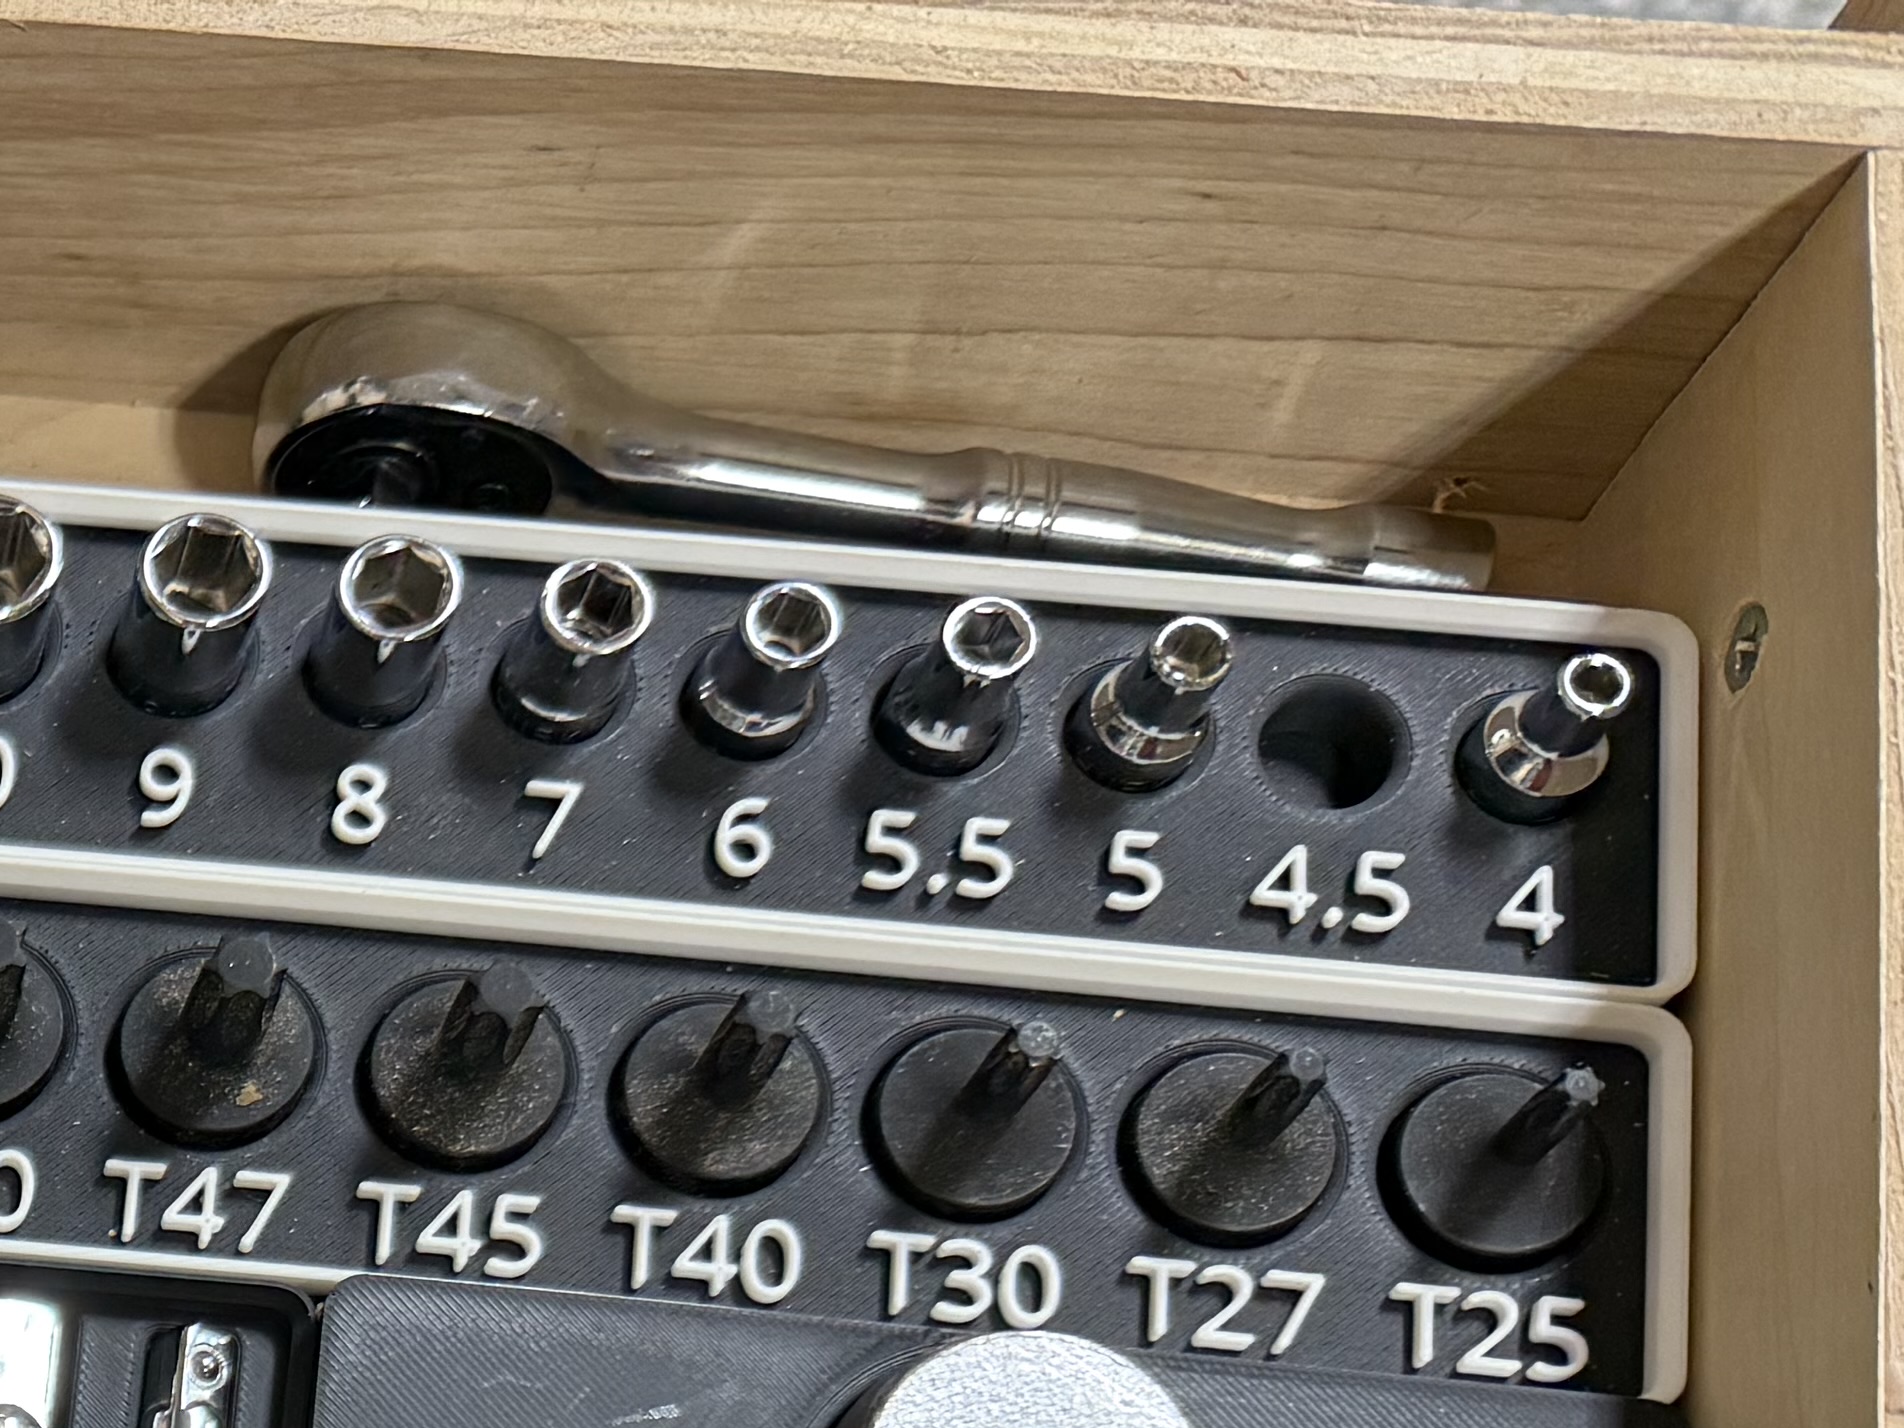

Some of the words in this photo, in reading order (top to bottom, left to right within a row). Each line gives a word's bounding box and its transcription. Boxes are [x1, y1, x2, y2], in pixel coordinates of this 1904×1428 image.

[139, 747, 197, 827] 9
[331, 762, 390, 844] 8
[525, 779, 585, 859] 7
[715, 796, 776, 878] 6
[861, 808, 1015, 898] 5.5
[1104, 828, 1165, 911] 5
[1249, 843, 1411, 933] 4.5
[1496, 864, 1565, 945] 4
[103, 1158, 294, 1254] T47
[356, 1180, 547, 1278] T45
[611, 1204, 804, 1304] T40
[867, 1229, 1064, 1330] T30
[1125, 1255, 1328, 1355] T27
[1388, 1281, 1588, 1382] T25
